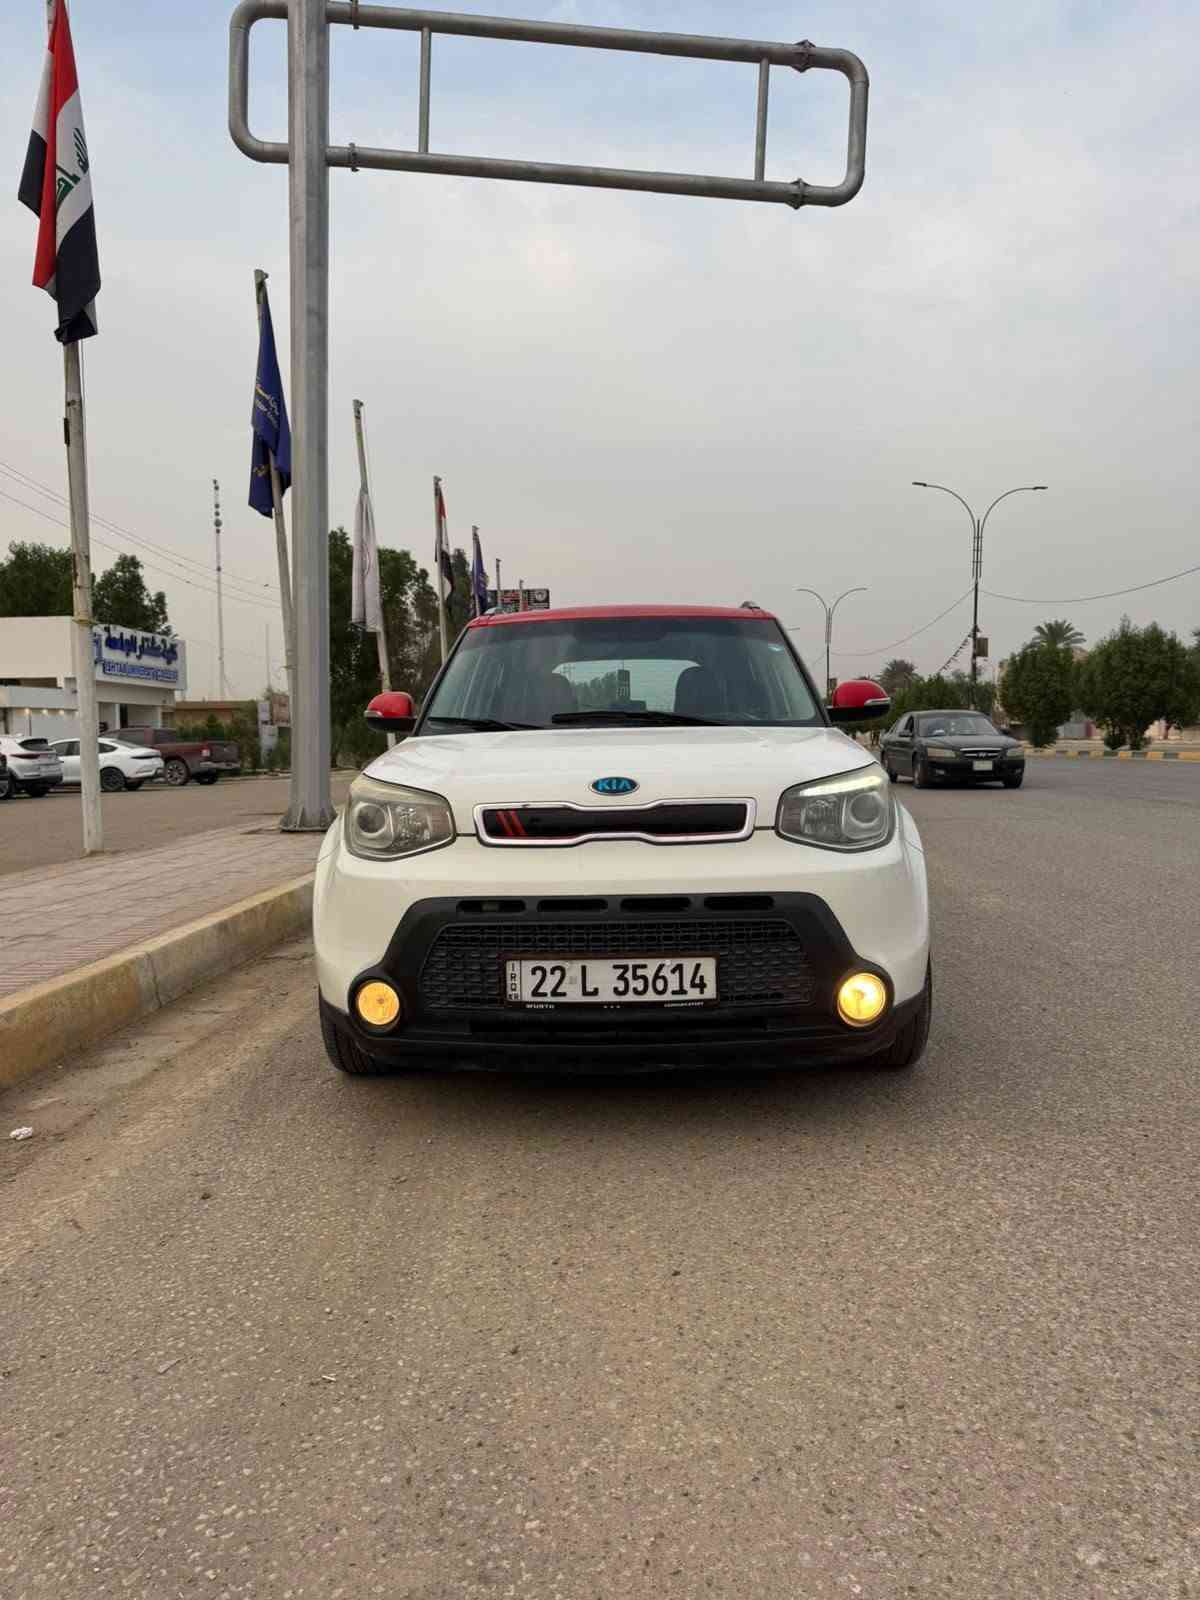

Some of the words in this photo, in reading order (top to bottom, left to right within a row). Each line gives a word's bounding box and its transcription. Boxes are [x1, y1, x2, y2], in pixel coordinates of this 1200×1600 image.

[597, 778, 632, 790] KIA
[530, 965, 567, 998] 22
[581, 964, 600, 997] L
[612, 962, 708, 997] 35614
